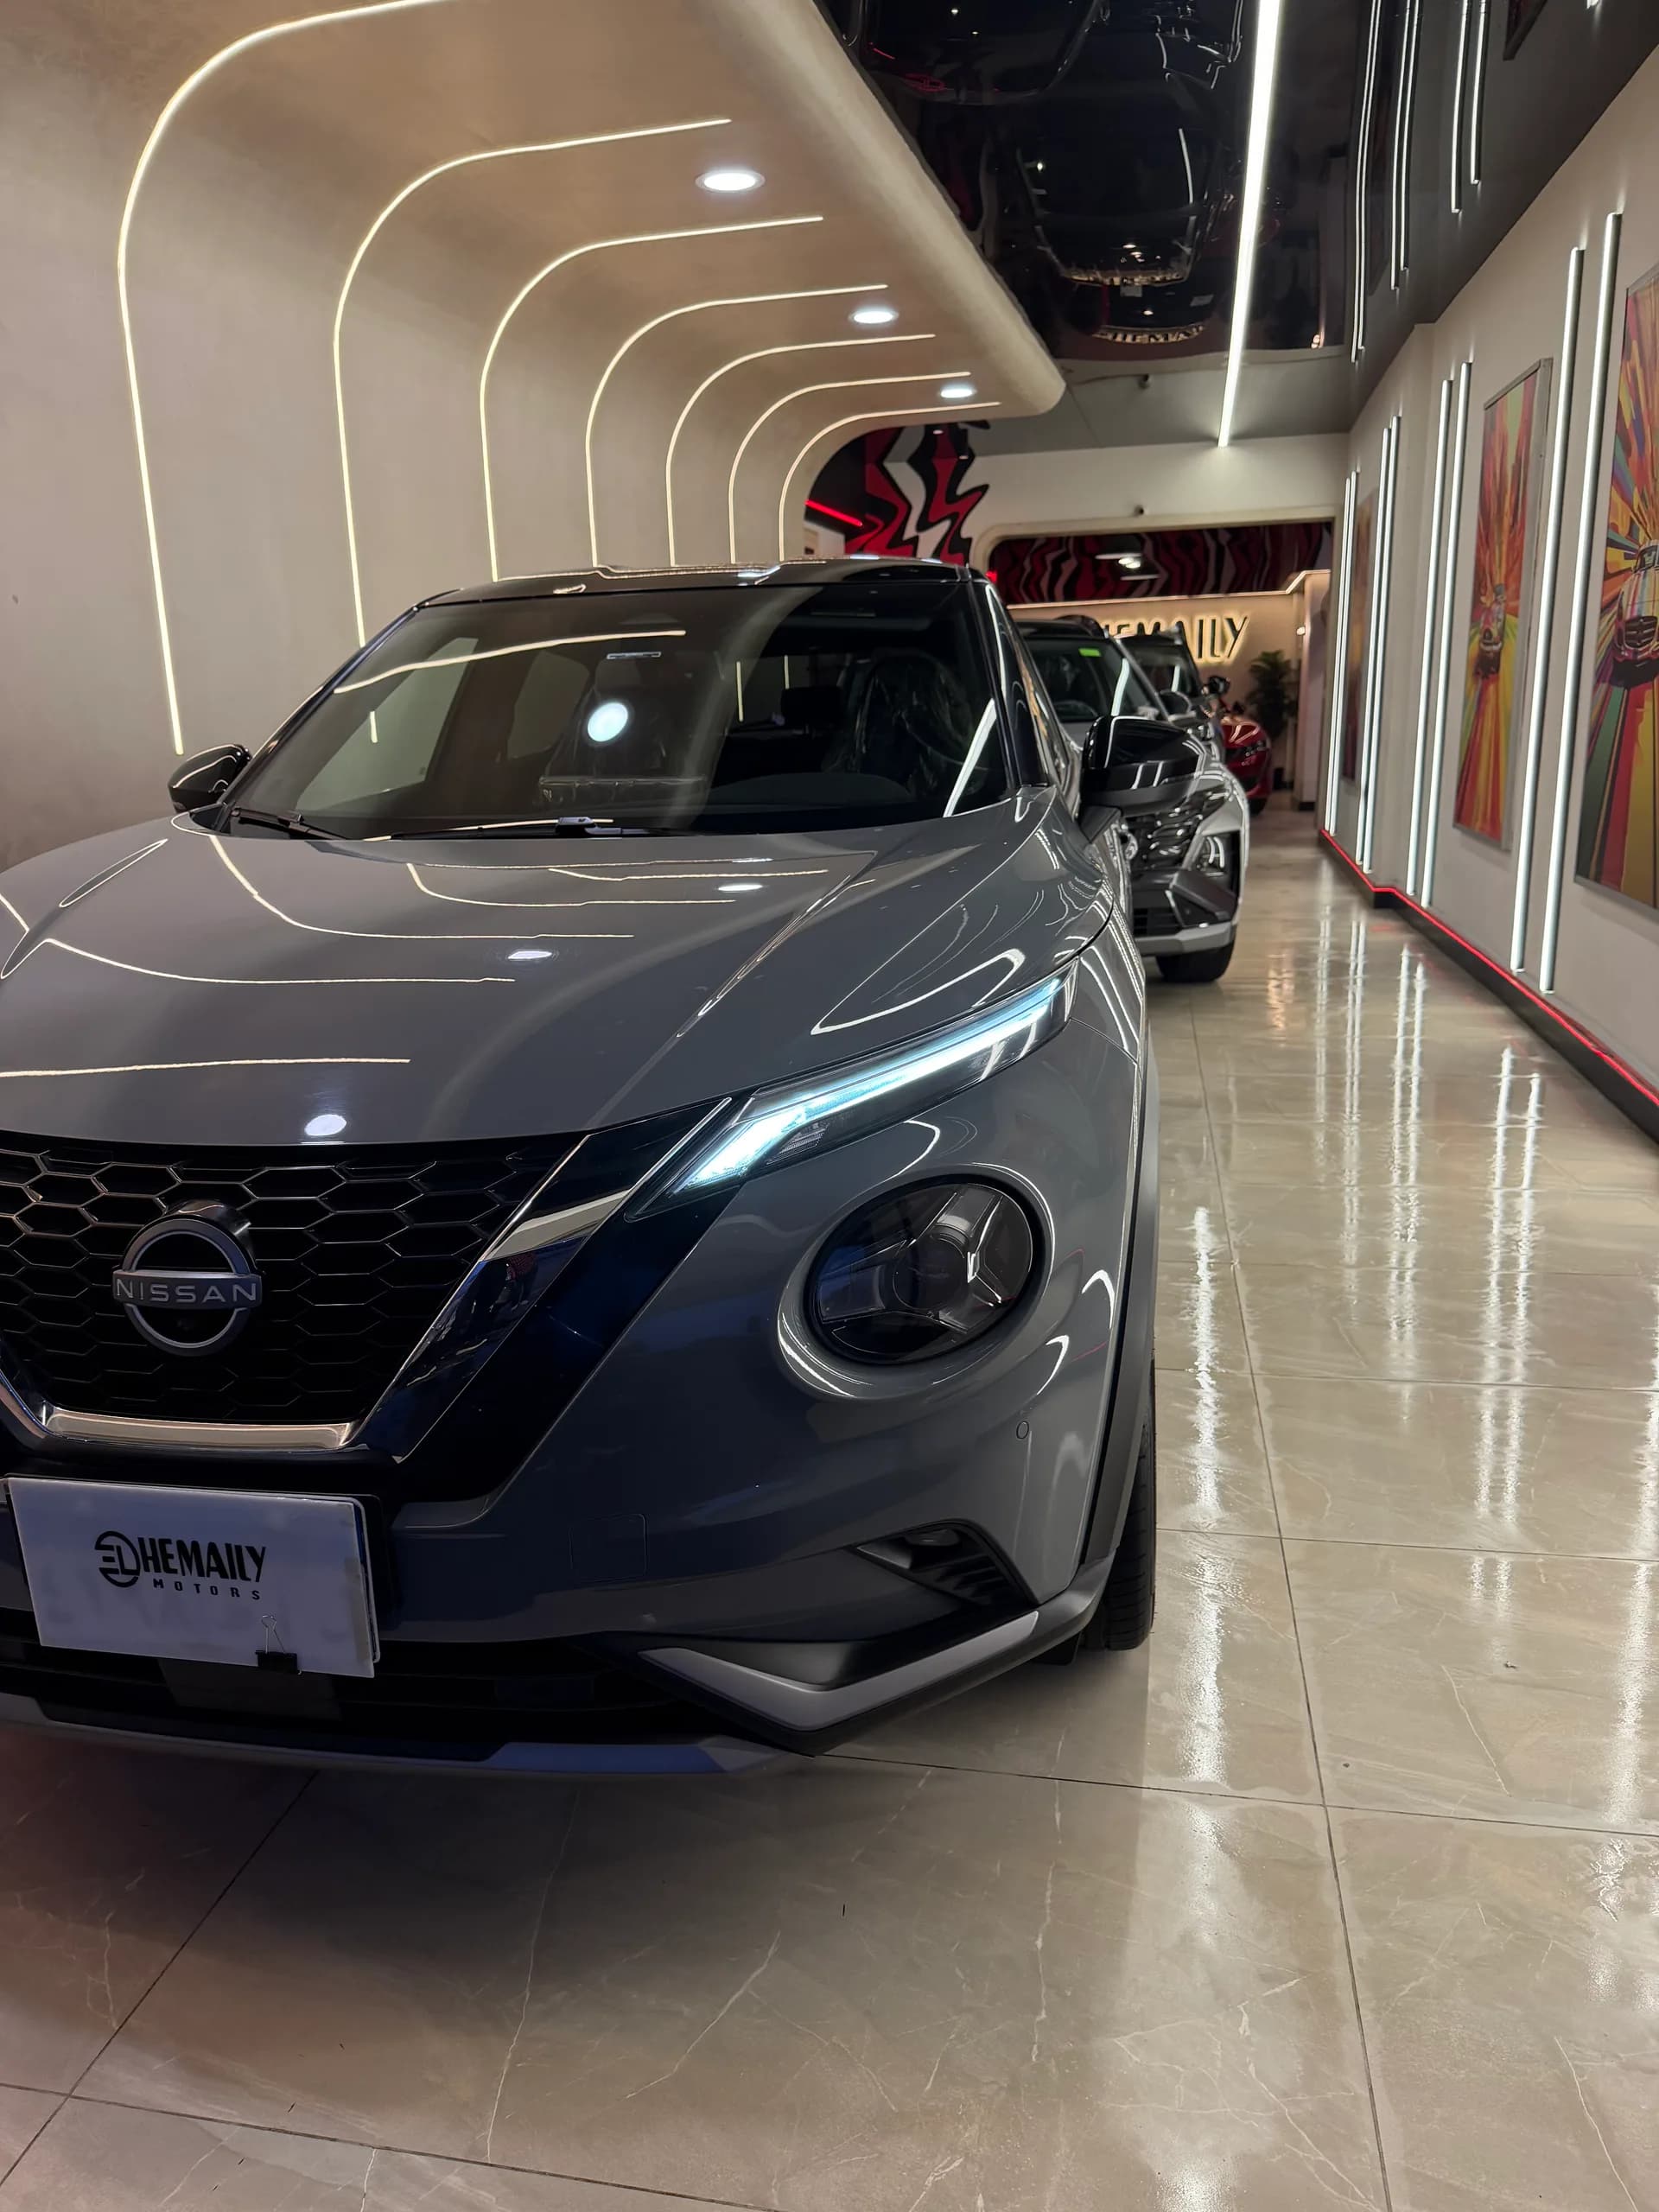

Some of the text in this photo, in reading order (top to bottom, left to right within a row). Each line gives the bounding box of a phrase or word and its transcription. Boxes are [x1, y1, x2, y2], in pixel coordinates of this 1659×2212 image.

[1103, 615, 1248, 659] AILY
[116, 1278, 257, 1304] NISSAN
[137, 1536, 267, 1583] HEMAILY
[152, 1578, 261, 1600] MOTORS
